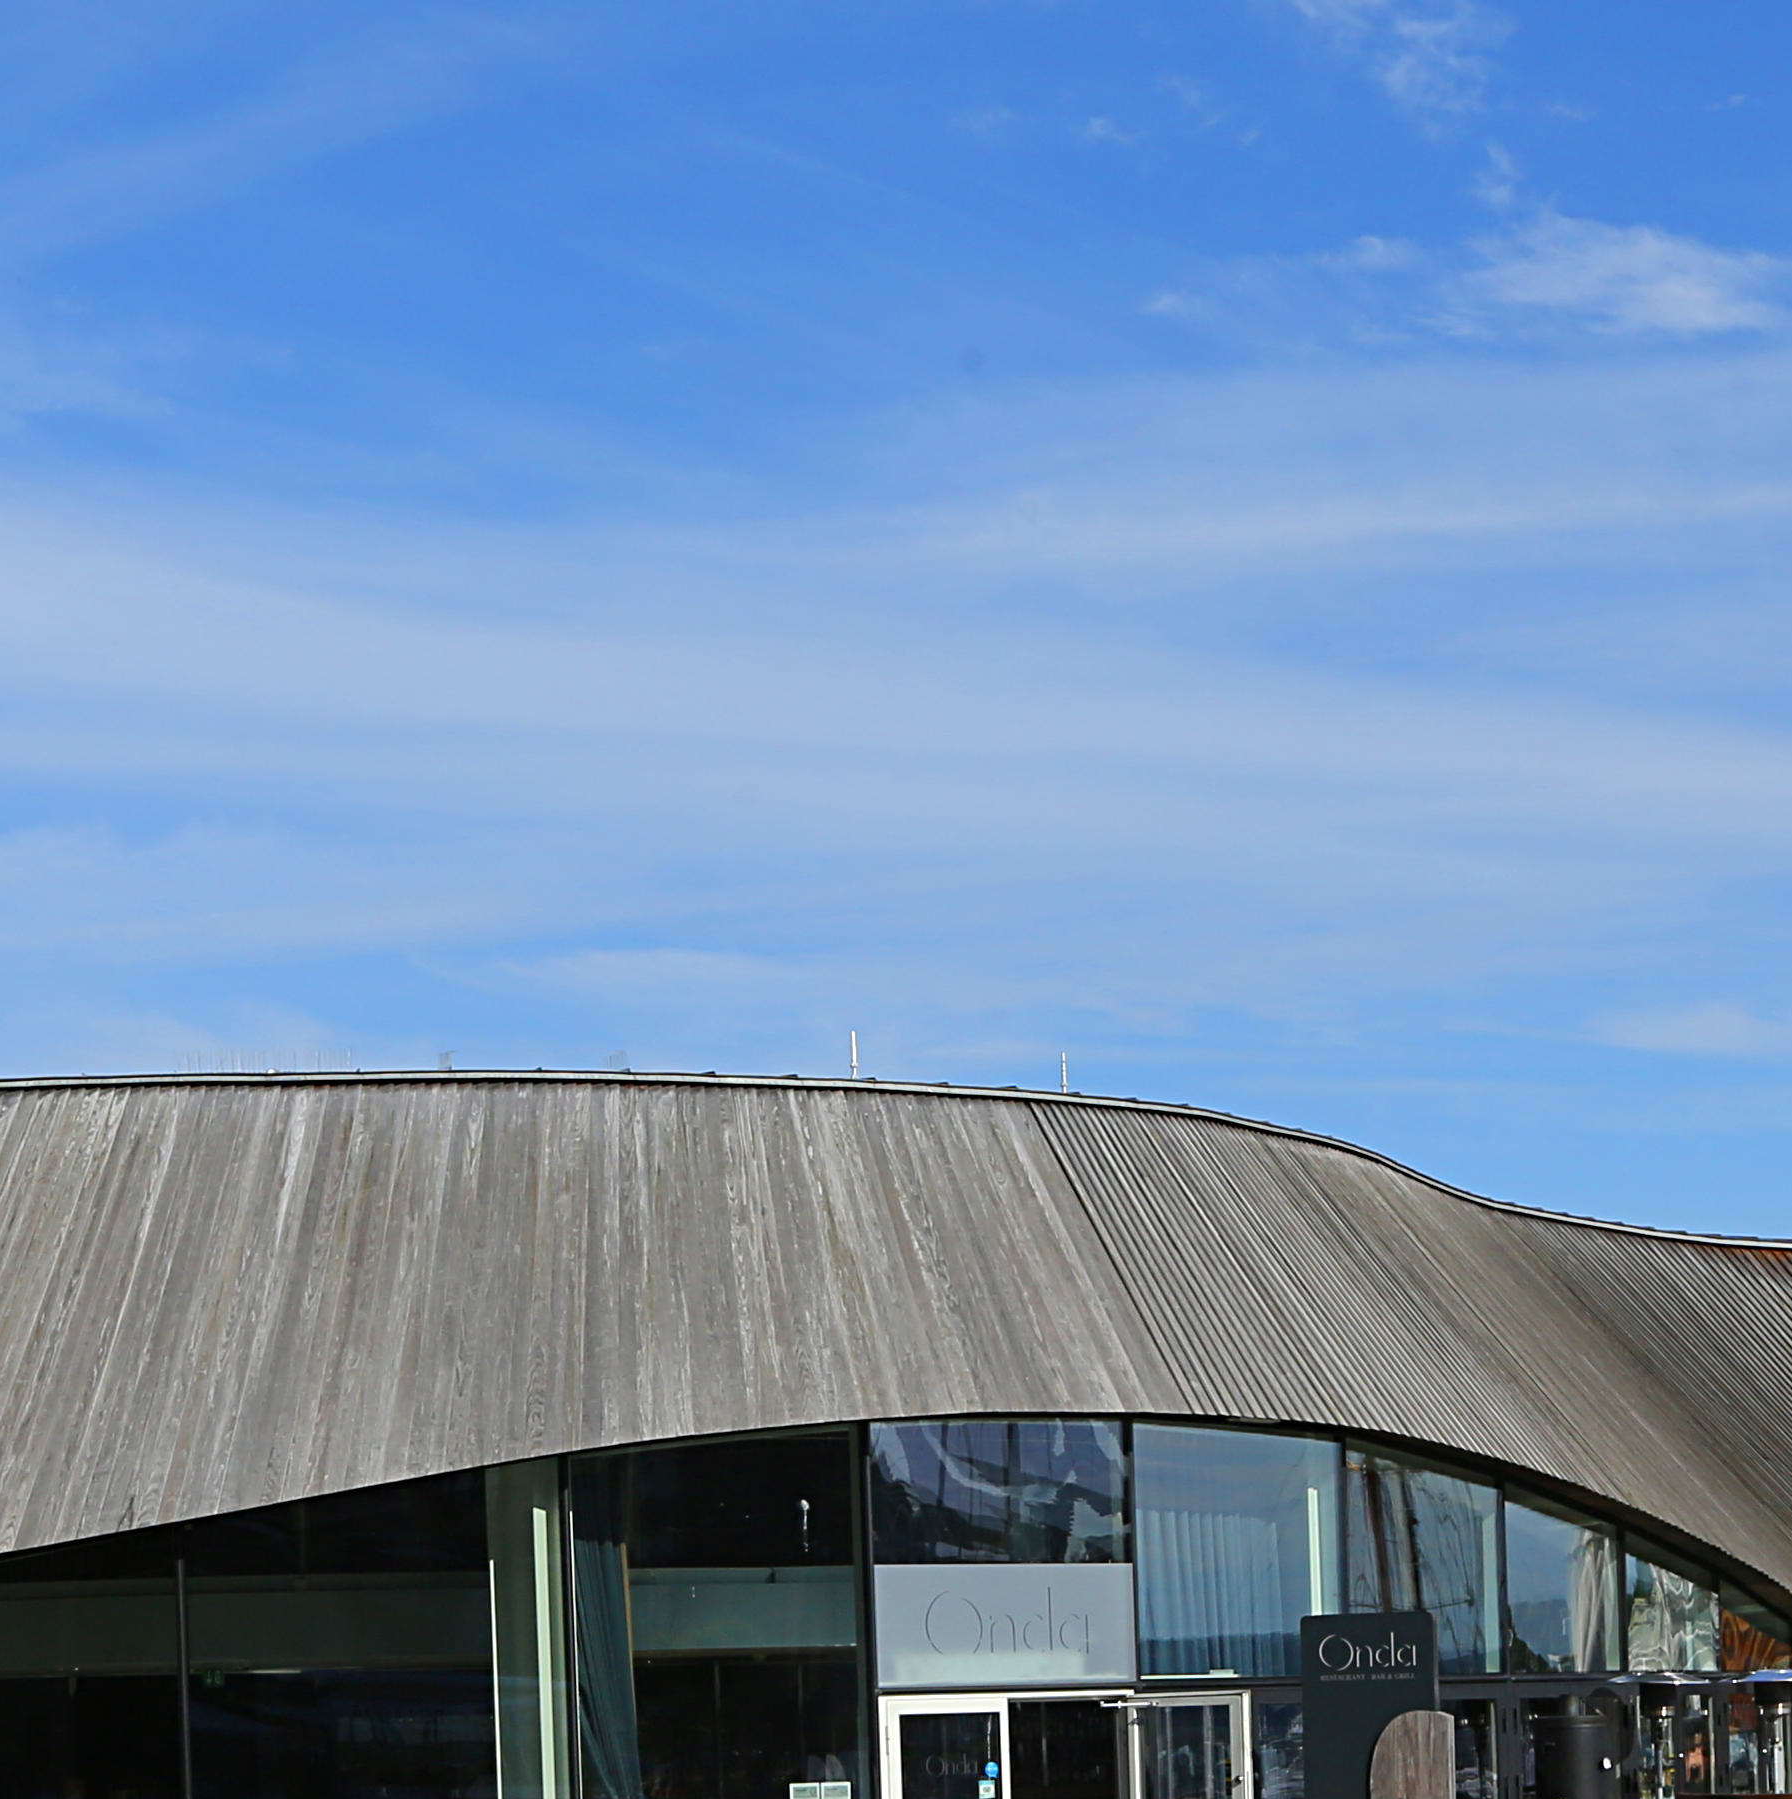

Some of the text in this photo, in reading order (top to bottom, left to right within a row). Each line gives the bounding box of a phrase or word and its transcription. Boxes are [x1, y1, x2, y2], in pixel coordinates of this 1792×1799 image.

[925, 1586, 1090, 1655] Onda
[1319, 1632, 1417, 1671] Onda
[925, 1752, 978, 1777] Onda
